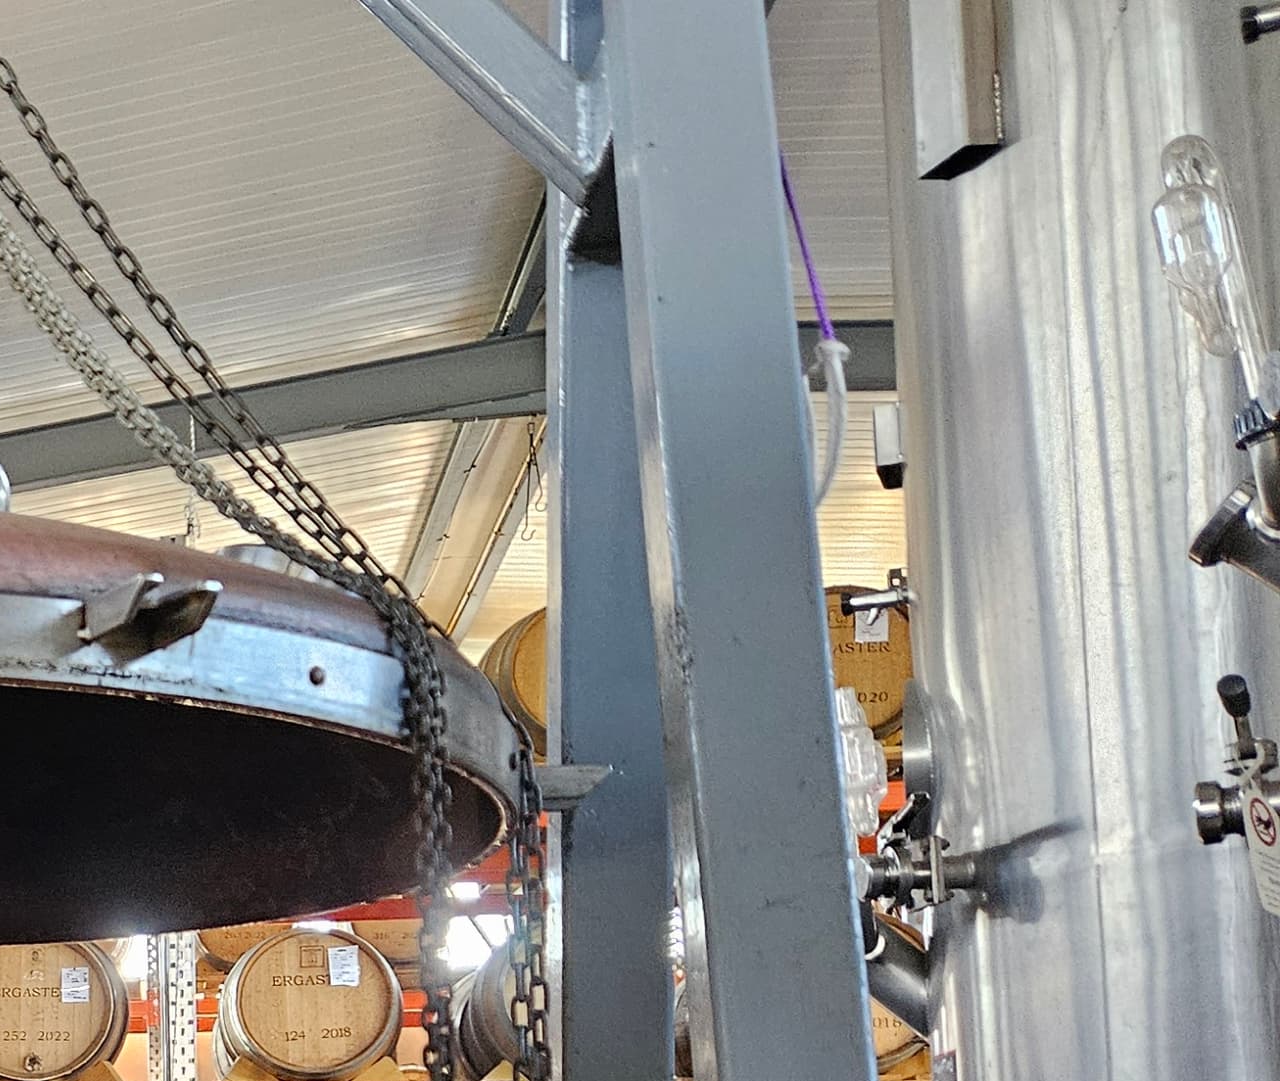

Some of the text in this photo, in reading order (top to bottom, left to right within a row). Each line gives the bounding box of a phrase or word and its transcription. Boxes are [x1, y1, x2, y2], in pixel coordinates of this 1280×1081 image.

[833, 641, 891, 654] ASTER
[857, 691, 889, 703] 020
[271, 974, 331, 988] ERGAS
[2, 1030, 71, 1042] 252 2022
[285, 1027, 352, 1042] 124 2018
